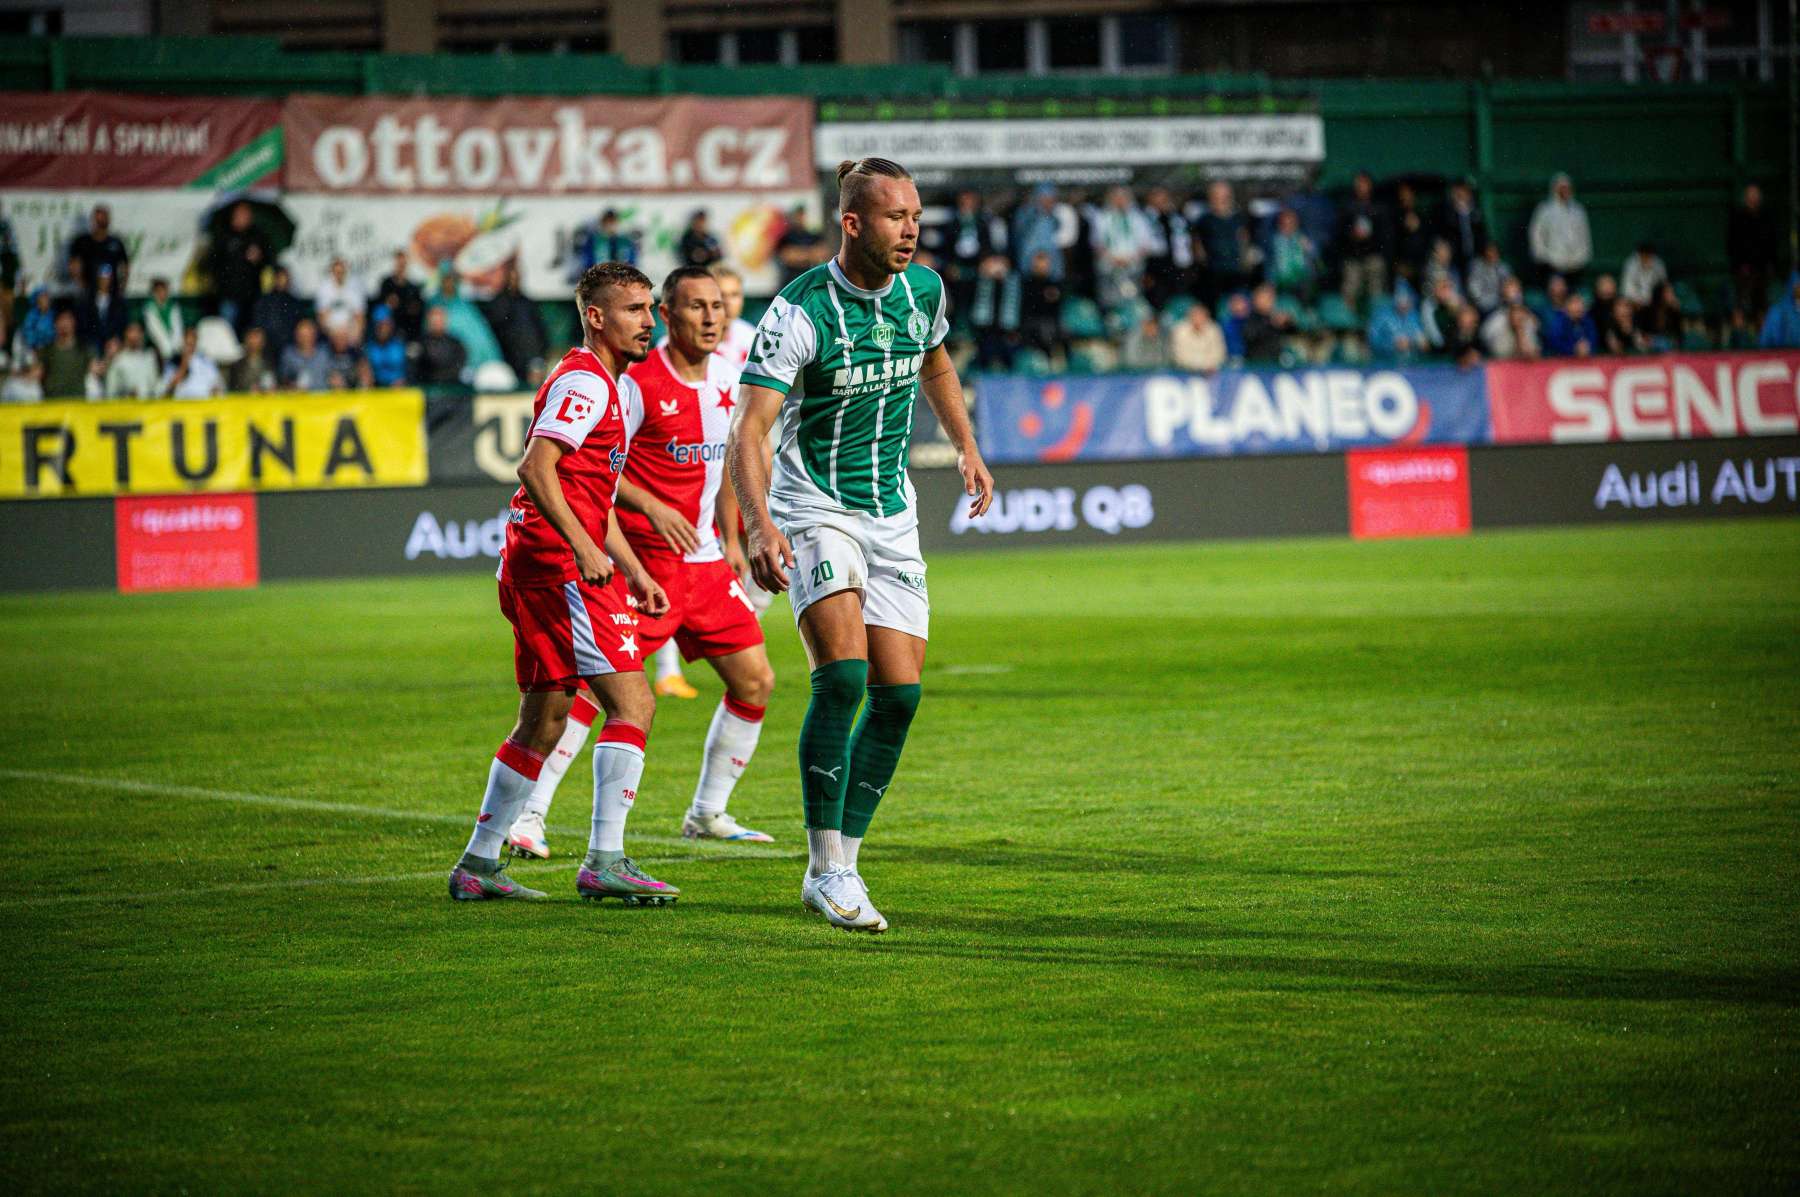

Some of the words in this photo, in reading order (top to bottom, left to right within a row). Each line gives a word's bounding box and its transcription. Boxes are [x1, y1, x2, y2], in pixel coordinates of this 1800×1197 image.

[313, 107, 792, 189] ottovka.cz
[832, 386, 861, 396] BARVY
[833, 352, 925, 387] BALSHO
[1144, 369, 1419, 446] PLANEO
[1546, 360, 1800, 443] SENC
[1081, 483, 1155, 534] Q8
[1594, 459, 1700, 508] Audi
[810, 559, 834, 588] 20
